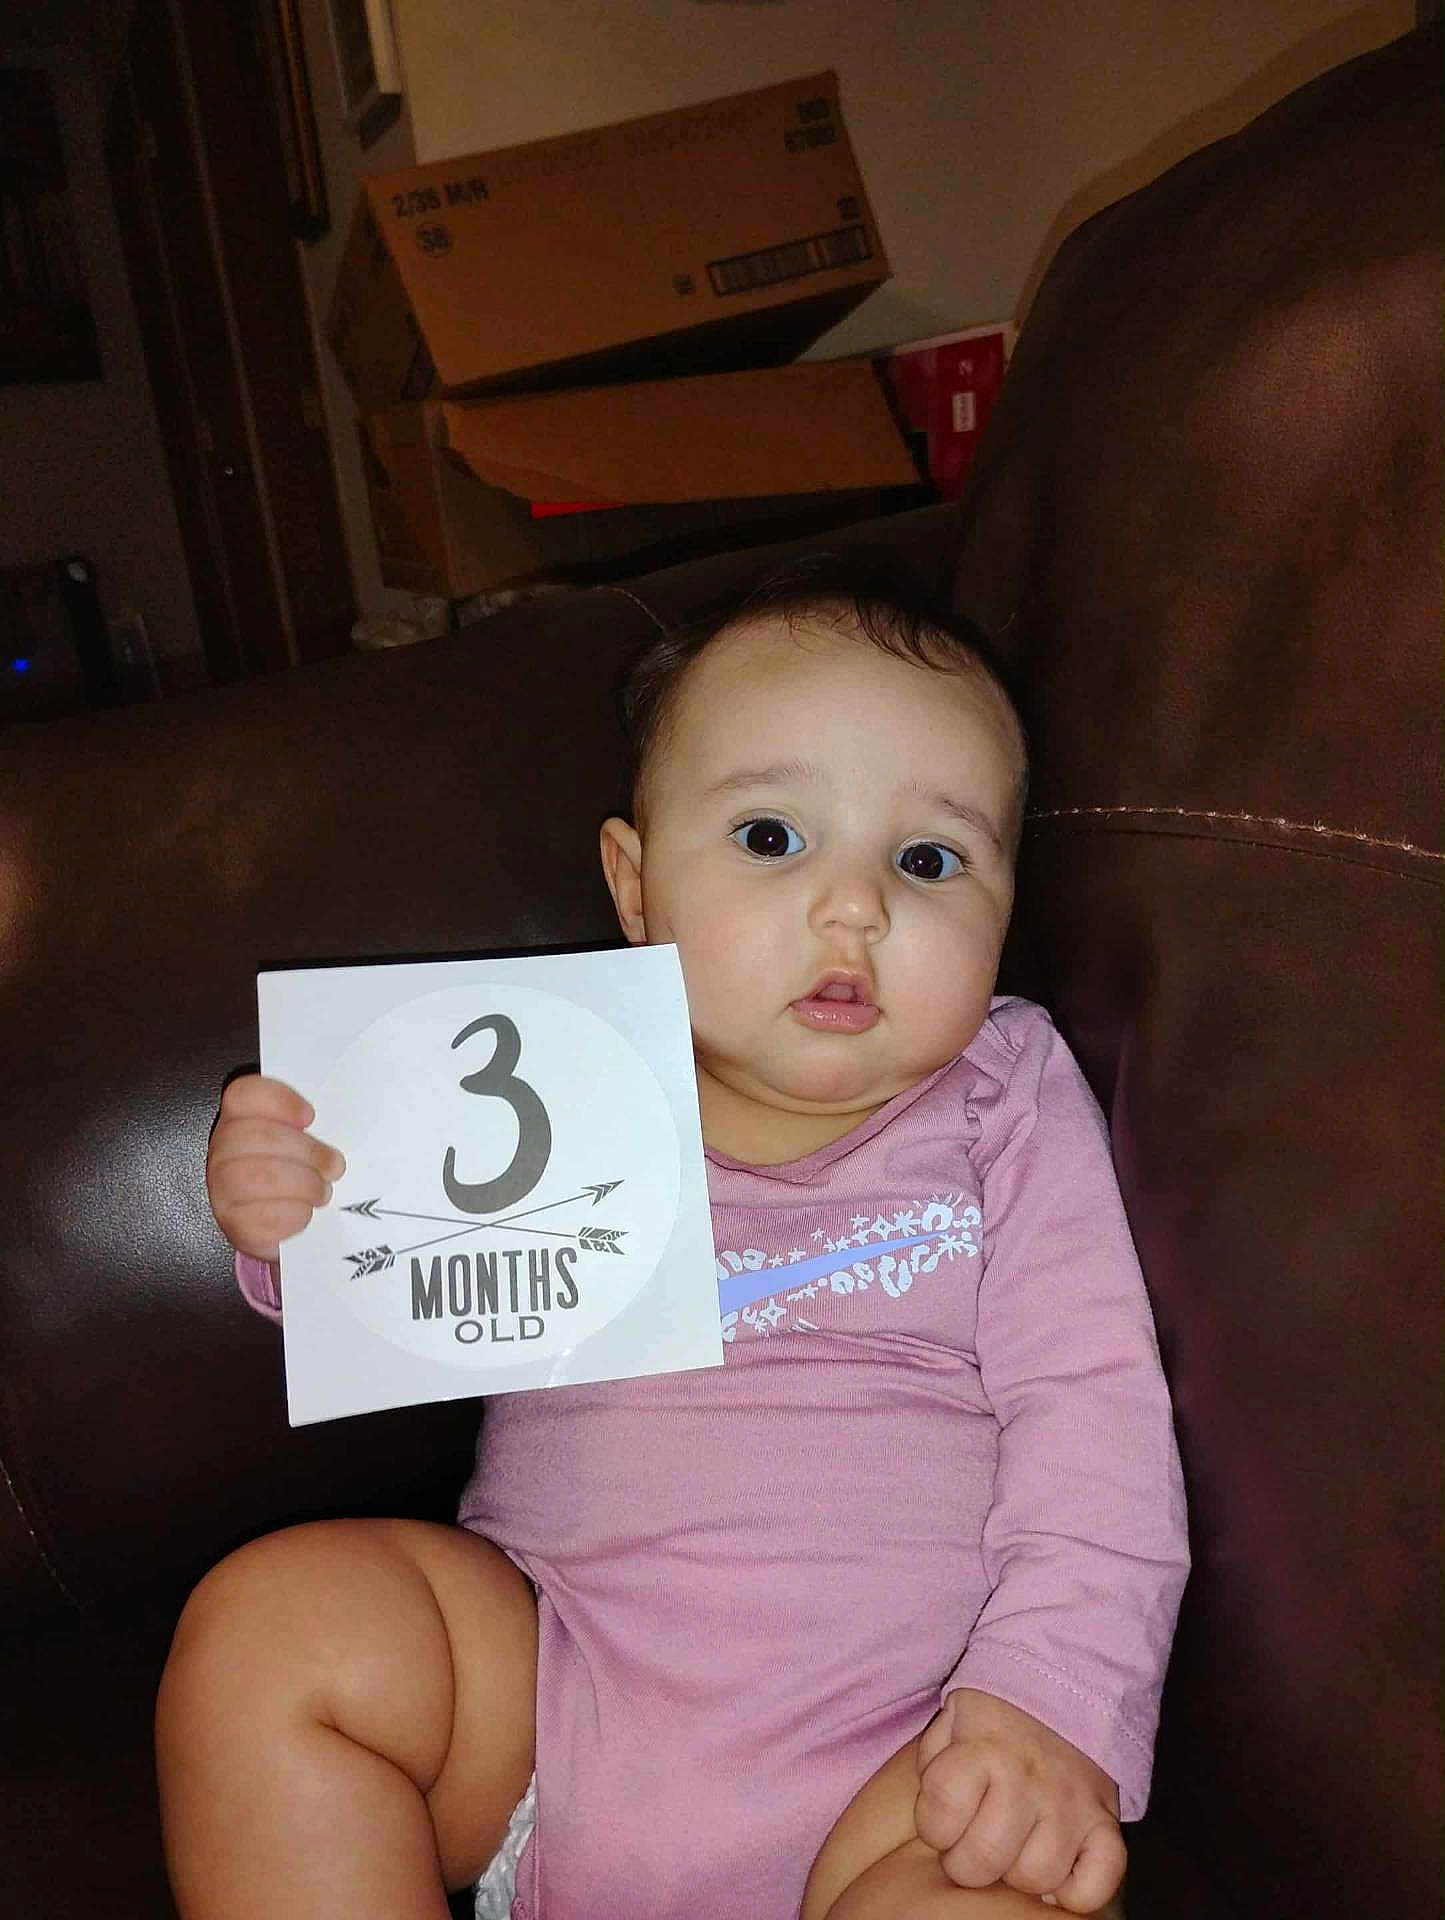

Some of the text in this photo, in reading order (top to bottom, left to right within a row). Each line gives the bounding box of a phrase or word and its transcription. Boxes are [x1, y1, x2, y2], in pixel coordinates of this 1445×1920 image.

[442, 1013, 552, 1215] 3
[410, 1246, 579, 1321] MONTHS
[454, 1315, 545, 1344] OLD
